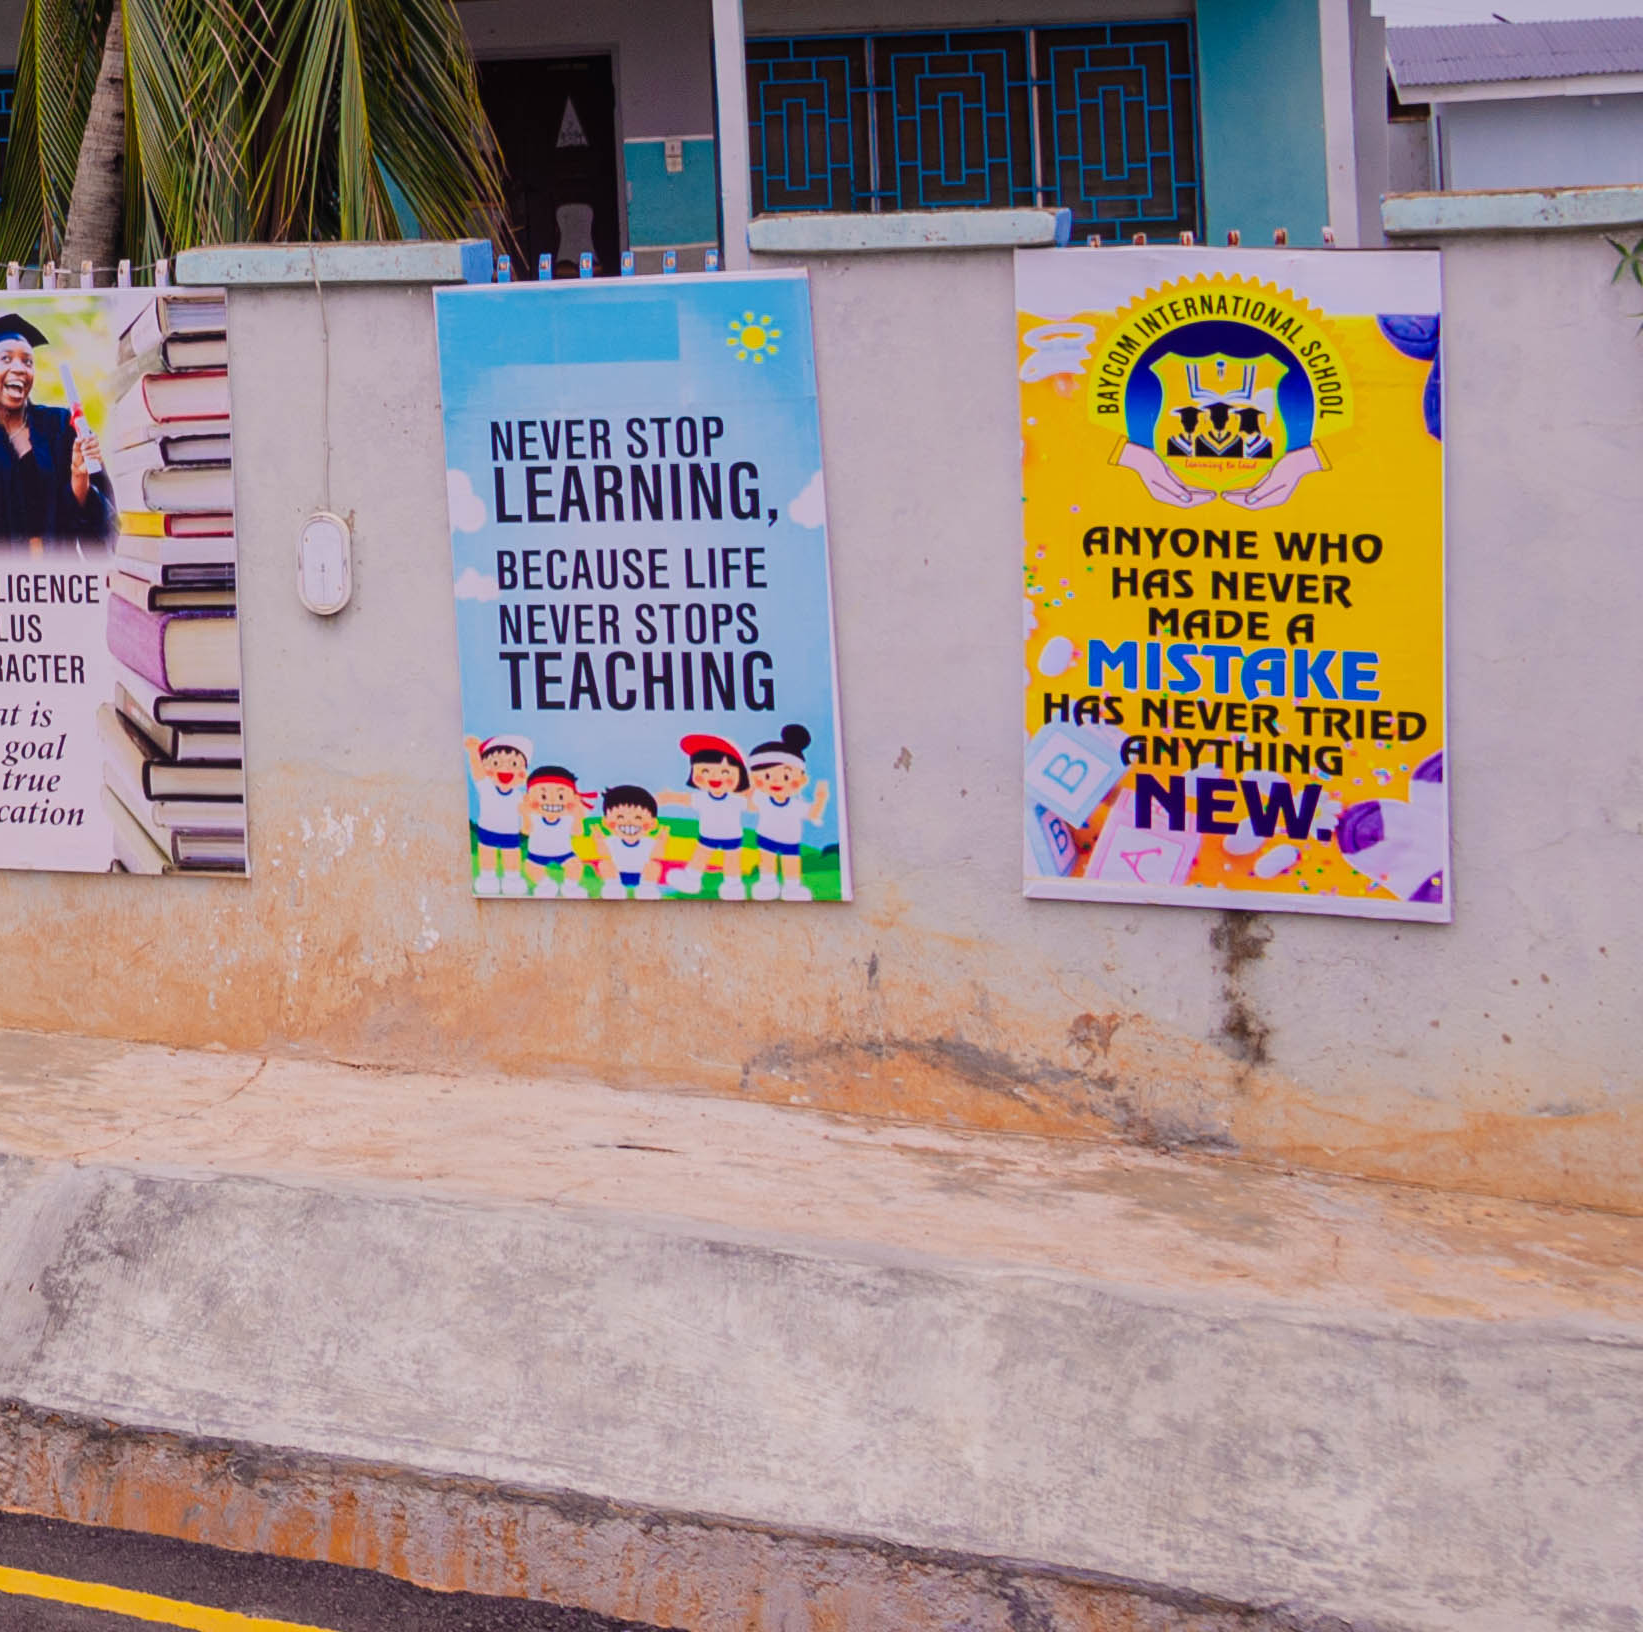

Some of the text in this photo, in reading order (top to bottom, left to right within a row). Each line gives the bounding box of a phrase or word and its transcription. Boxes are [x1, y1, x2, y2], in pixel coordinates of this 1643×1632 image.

[1097, 294, 1344, 419] BAYCOM INTERNATIONAL SCHOOL
[490, 415, 725, 462] NEVER STOP
[493, 461, 779, 529] LEARNING,
[1082, 525, 1383, 566] ANYONE WHO
[497, 547, 768, 591] BECAUSE LIFE
[1112, 567, 1353, 609] HAS NEVER
[499, 602, 759, 646] NEVER STOPS
[1148, 607, 1315, 646] MADE A
[499, 649, 776, 713] TEACHING
[1087, 638, 1381, 703] MISTAKE
[29, 702, 53, 728] is
[1042, 693, 1428, 744] HAS NEVER TRIED
[3, 733, 67, 767] goal
[1120, 734, 1344, 777] ANYTHING
[3, 766, 61, 793] true
[1043, 752, 1088, 794] B
[1134, 773, 1333, 843] NEW.
